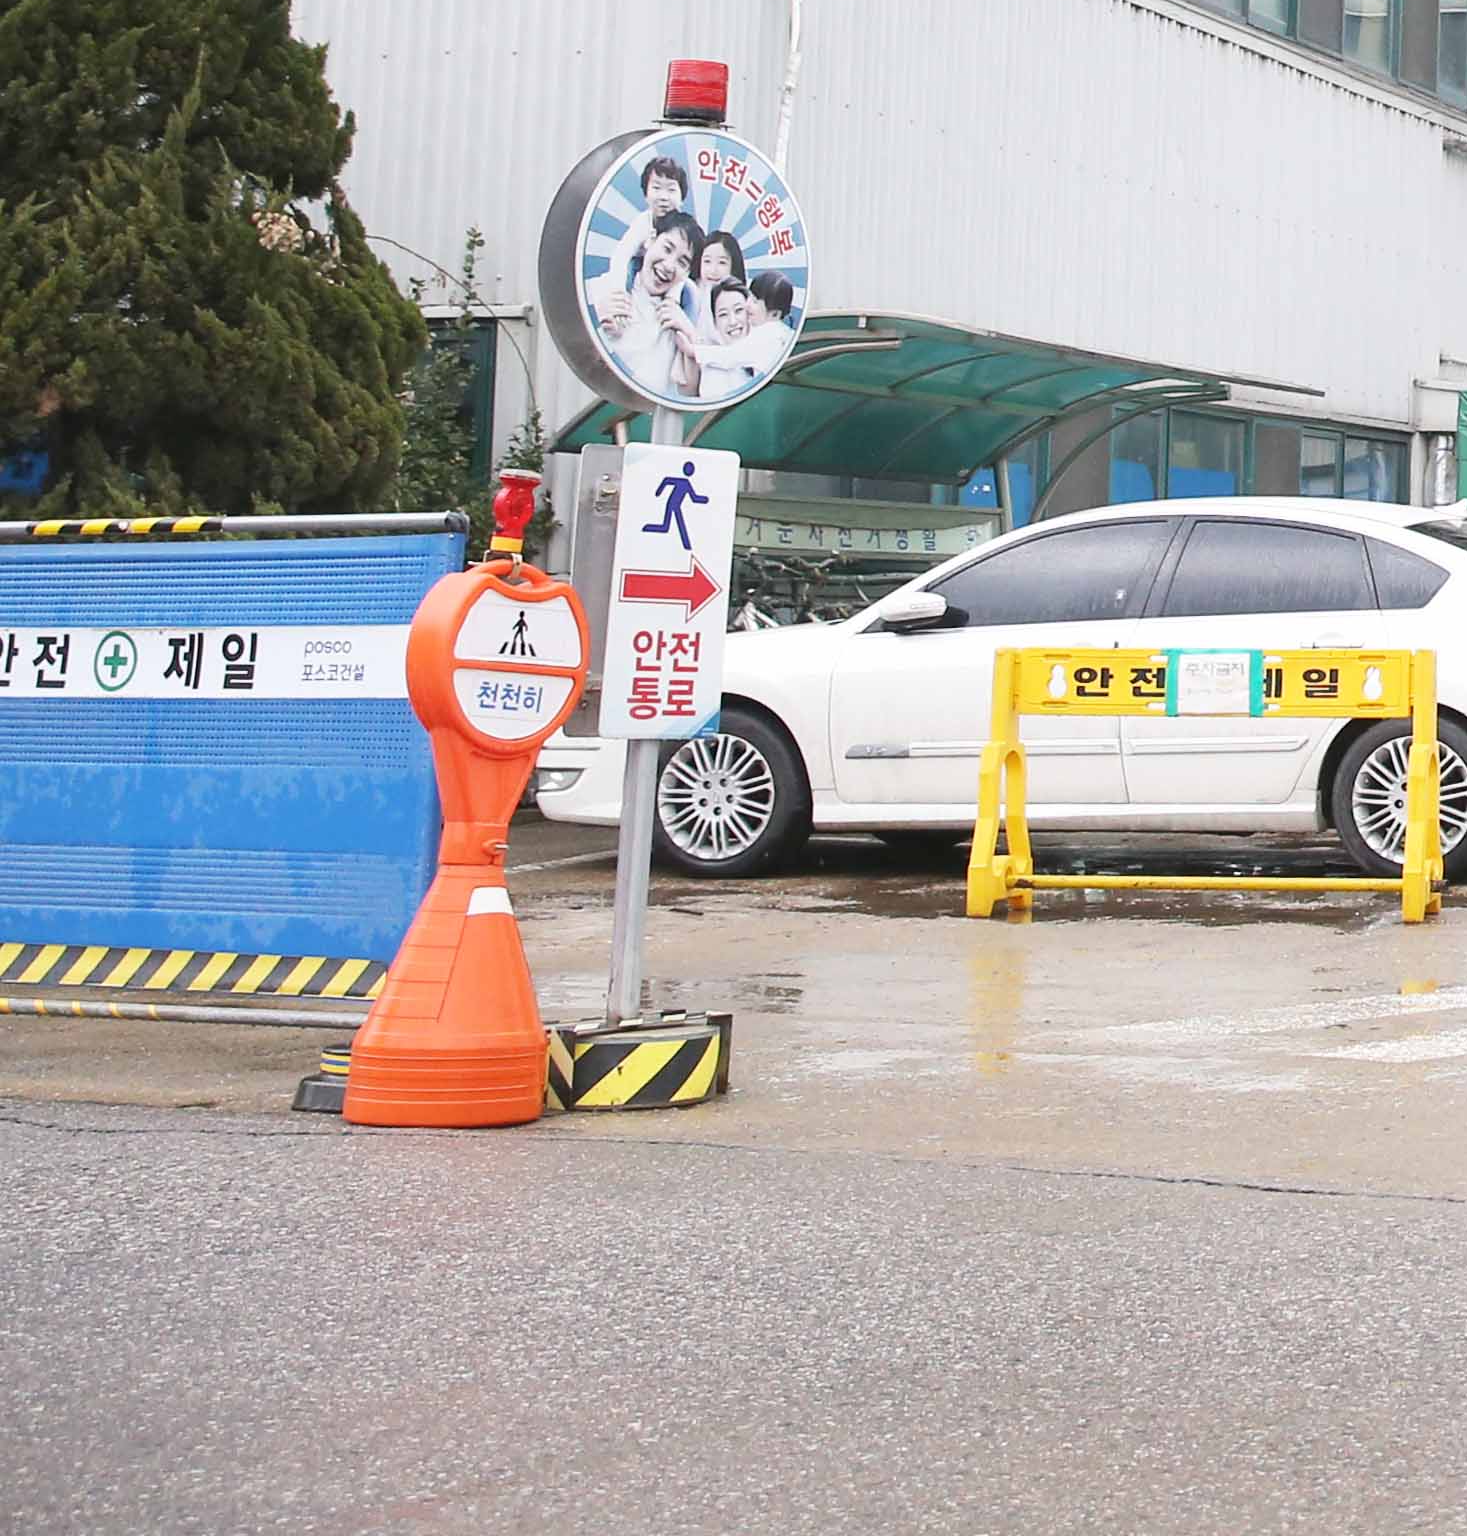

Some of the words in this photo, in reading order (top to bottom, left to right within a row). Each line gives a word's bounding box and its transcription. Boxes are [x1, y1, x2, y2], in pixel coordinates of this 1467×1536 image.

[163, 632, 258, 690] 제일
[303, 638, 352, 659] posco
[632, 630, 701, 673] 안전
[301, 663, 365, 682] 포스코건설
[1073, 667, 1166, 698] 안전
[476, 681, 544, 713] 천천히
[626, 677, 697, 720] 통로
